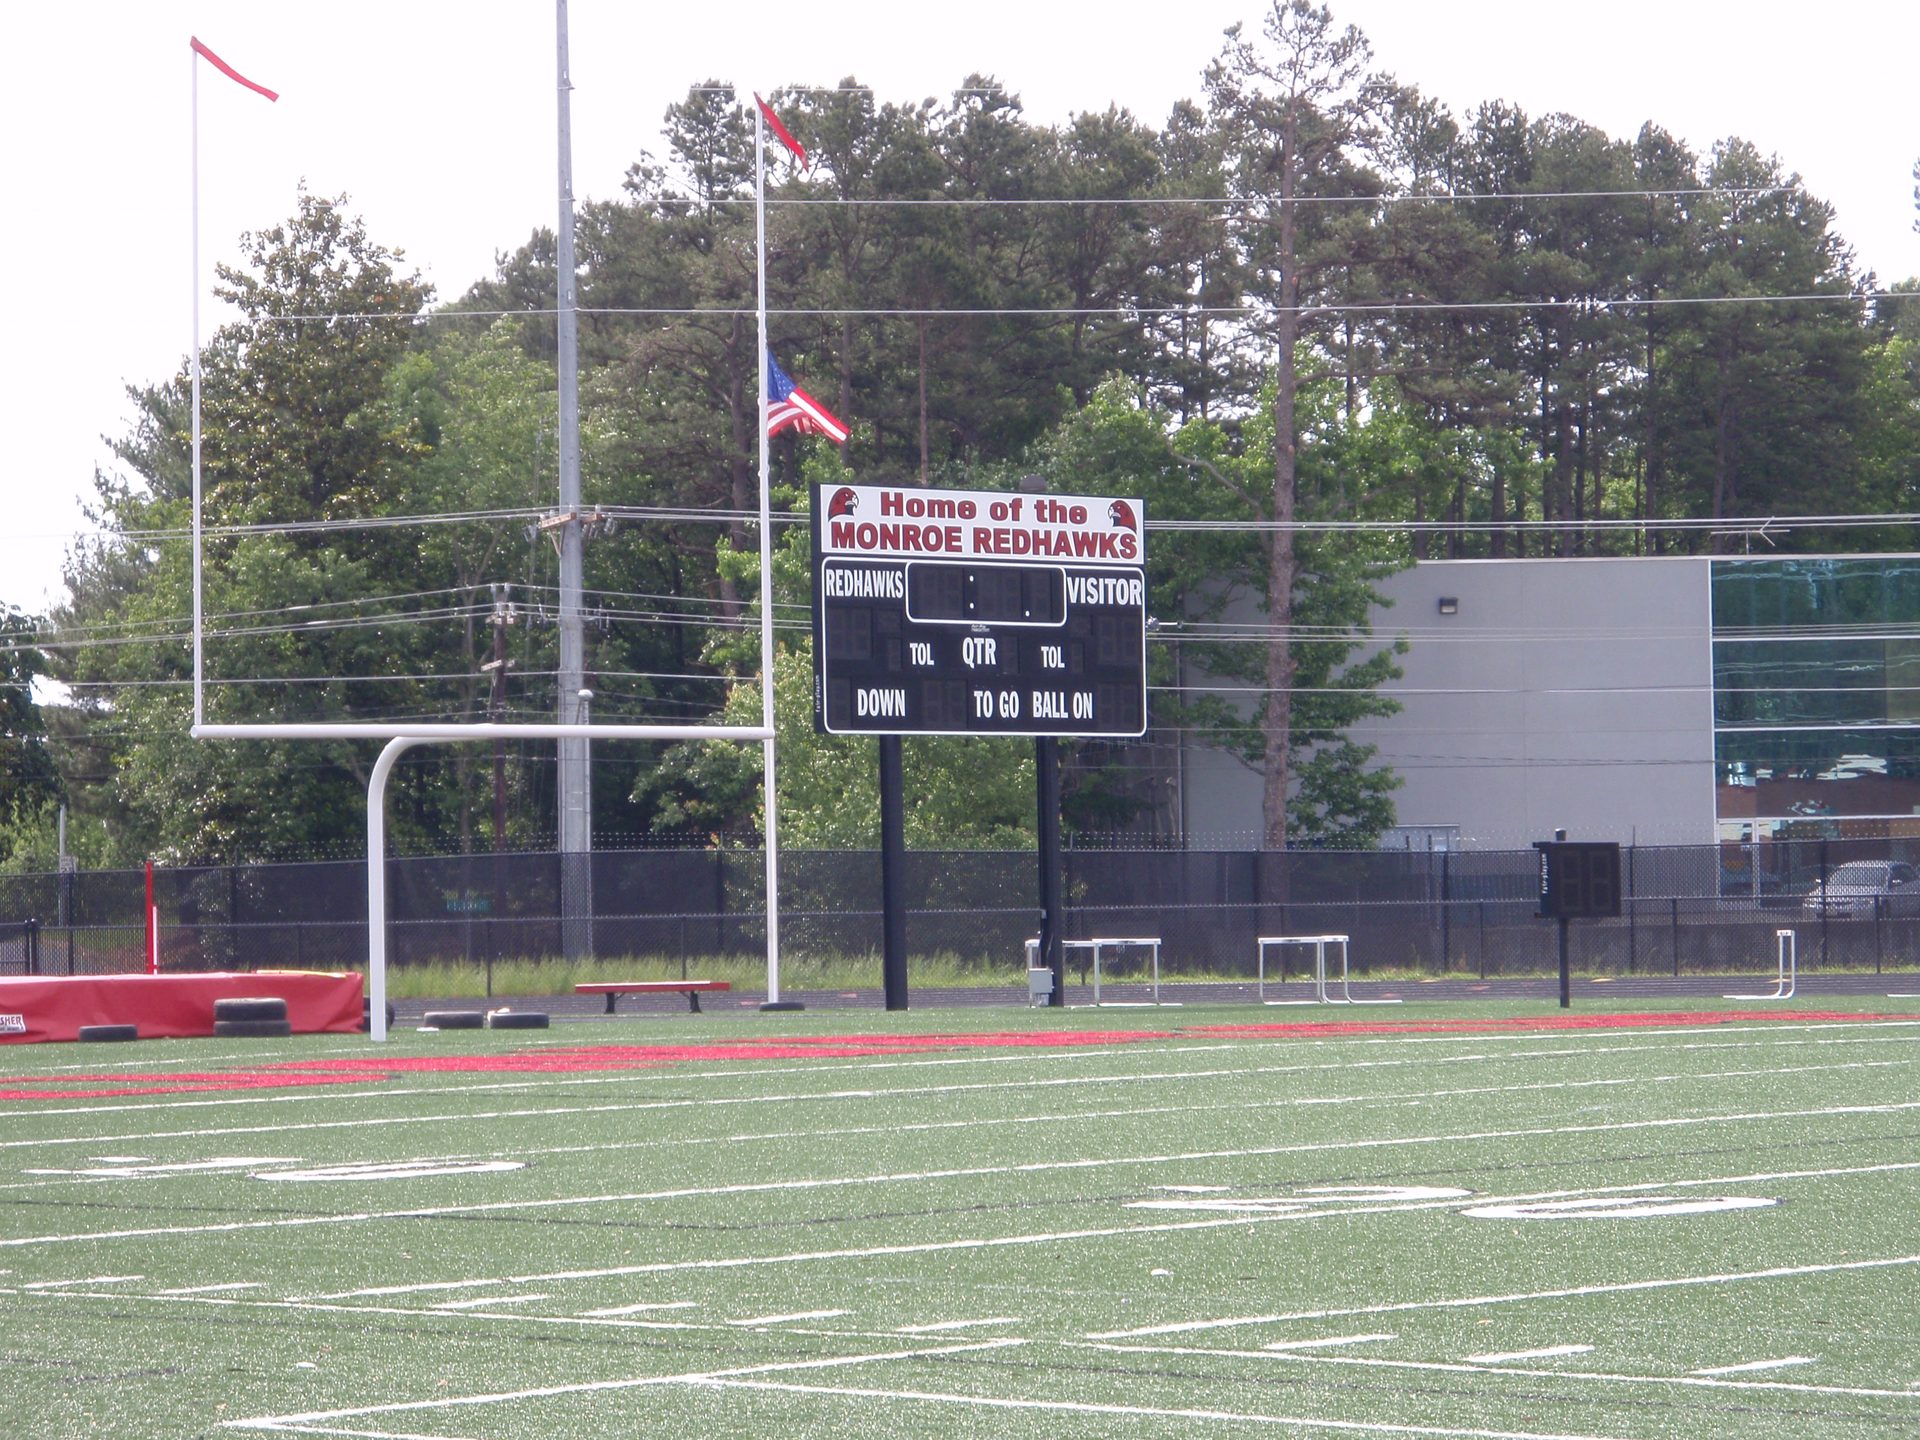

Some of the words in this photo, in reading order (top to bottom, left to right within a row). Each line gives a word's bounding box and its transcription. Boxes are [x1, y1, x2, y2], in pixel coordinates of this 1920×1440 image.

[880, 491, 977, 519] Home
[989, 497, 1022, 521] of
[1034, 499, 1088, 524] the
[831, 521, 963, 553] MONROE
[973, 527, 1138, 559] REDHAWKS
[825, 568, 903, 598] REDHAWKS
[1067, 576, 1142, 605] VISITOR
[909, 643, 934, 665] TOL
[962, 637, 996, 669] QTR
[1041, 646, 1065, 668] TOL
[857, 688, 905, 717] DOWN
[974, 690, 993, 718] TO
[999, 691, 1019, 718] GO
[1033, 691, 1068, 719] BALL
[1073, 692, 1093, 719] ON
